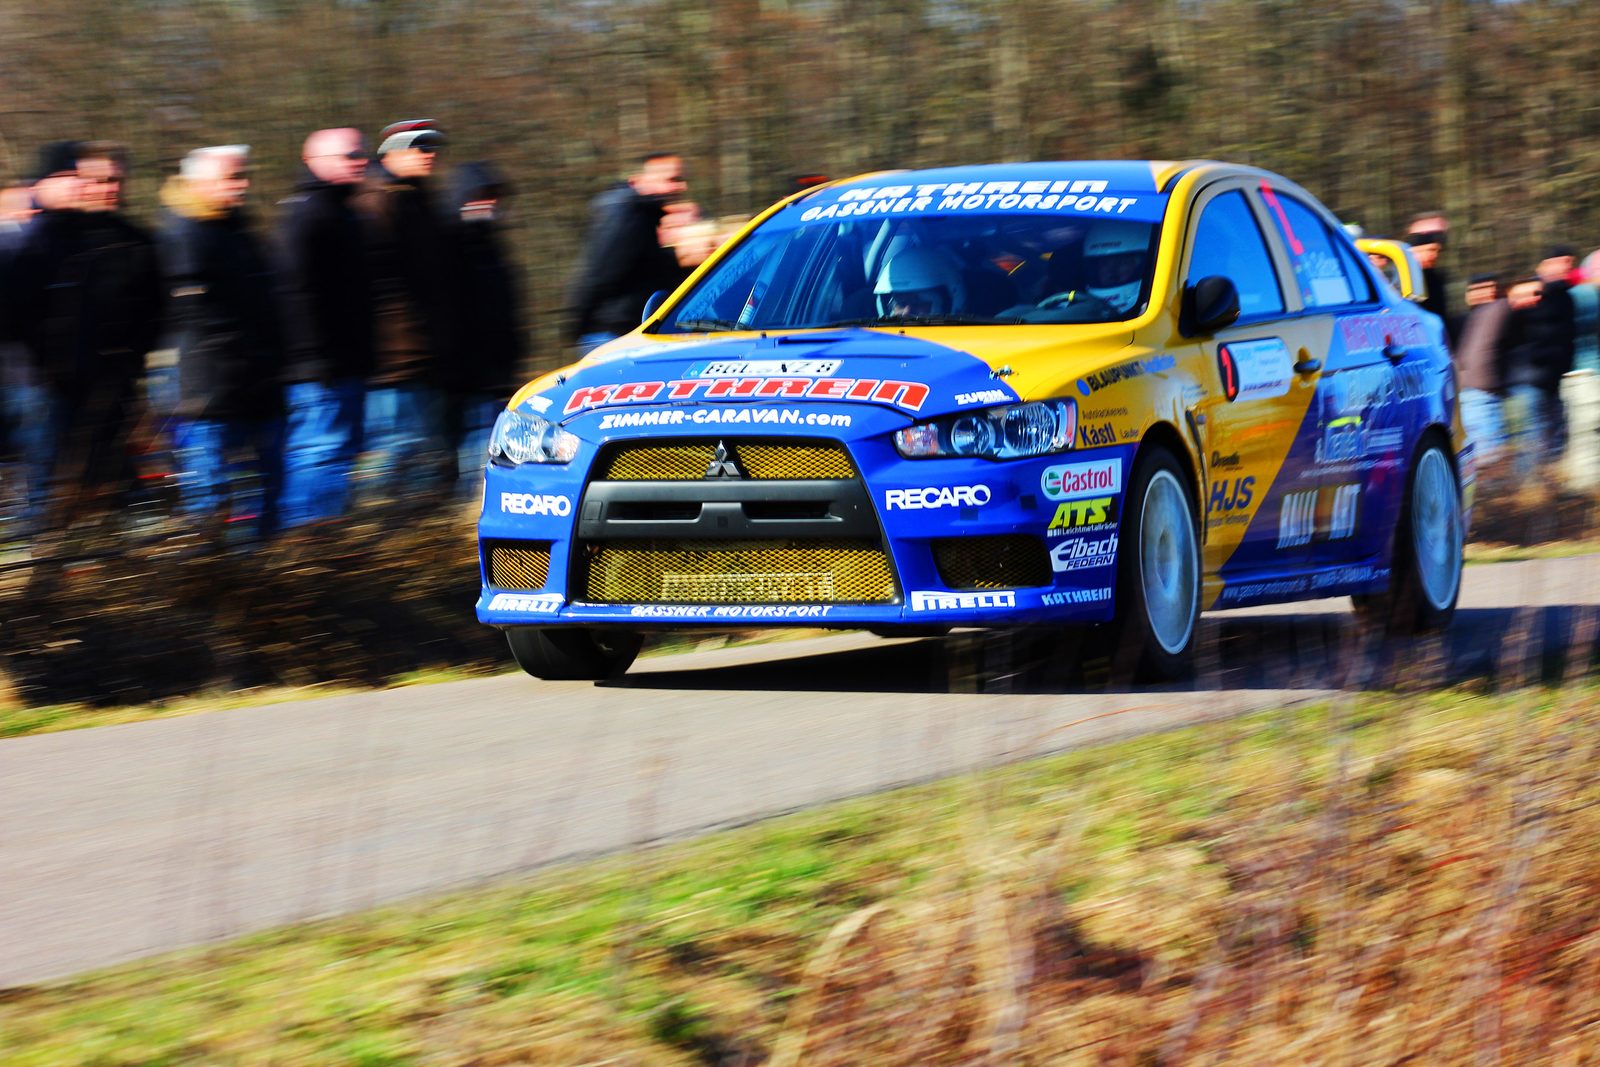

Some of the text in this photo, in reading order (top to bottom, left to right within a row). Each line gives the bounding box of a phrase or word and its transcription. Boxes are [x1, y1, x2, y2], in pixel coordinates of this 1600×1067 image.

[837, 180, 1109, 202] KATHREIN
[799, 194, 1138, 222] GASSNER MOTORSPORT
[562, 376, 931, 415] KATHREIN
[598, 408, 852, 430] ZIMMER-CARAVAN.com
[1060, 466, 1115, 493] Castrol
[501, 492, 572, 517] RECARO
[885, 484, 992, 511] RECARO
[1207, 475, 1256, 513] HJS
[1048, 496, 1112, 530] ATS
[1050, 533, 1119, 566] Eibach
[1066, 554, 1113, 570] FEDERN
[488, 593, 566, 613] PIRELLI
[910, 590, 1016, 612] PIRELLI
[1041, 586, 1112, 608] KATHREIN
[630, 603, 834, 618] GASSNER MOTORSPORT
